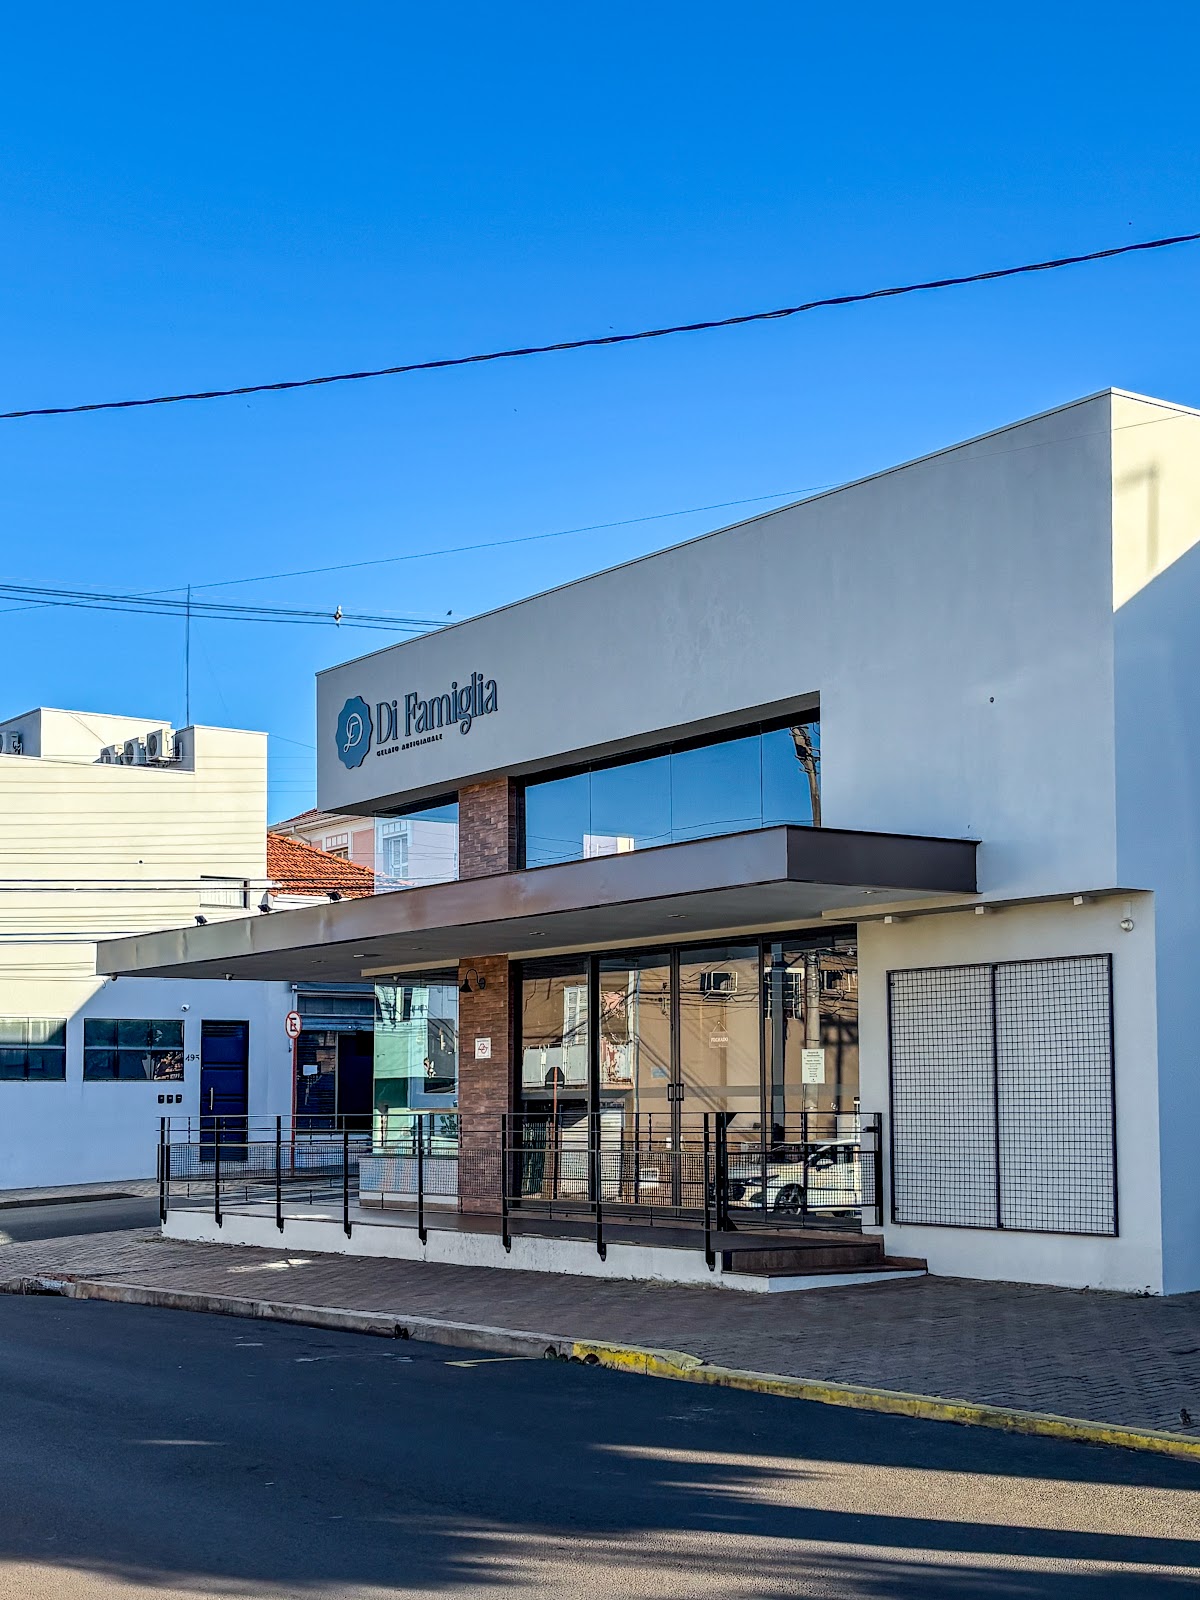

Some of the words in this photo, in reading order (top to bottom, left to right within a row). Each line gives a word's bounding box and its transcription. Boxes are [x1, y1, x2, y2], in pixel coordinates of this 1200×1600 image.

[376, 700, 398, 745] Di
[405, 672, 498, 735] Famiglia
[376, 746, 399, 757] GELATO
[401, 733, 443, 750] ARTIGIANALE
